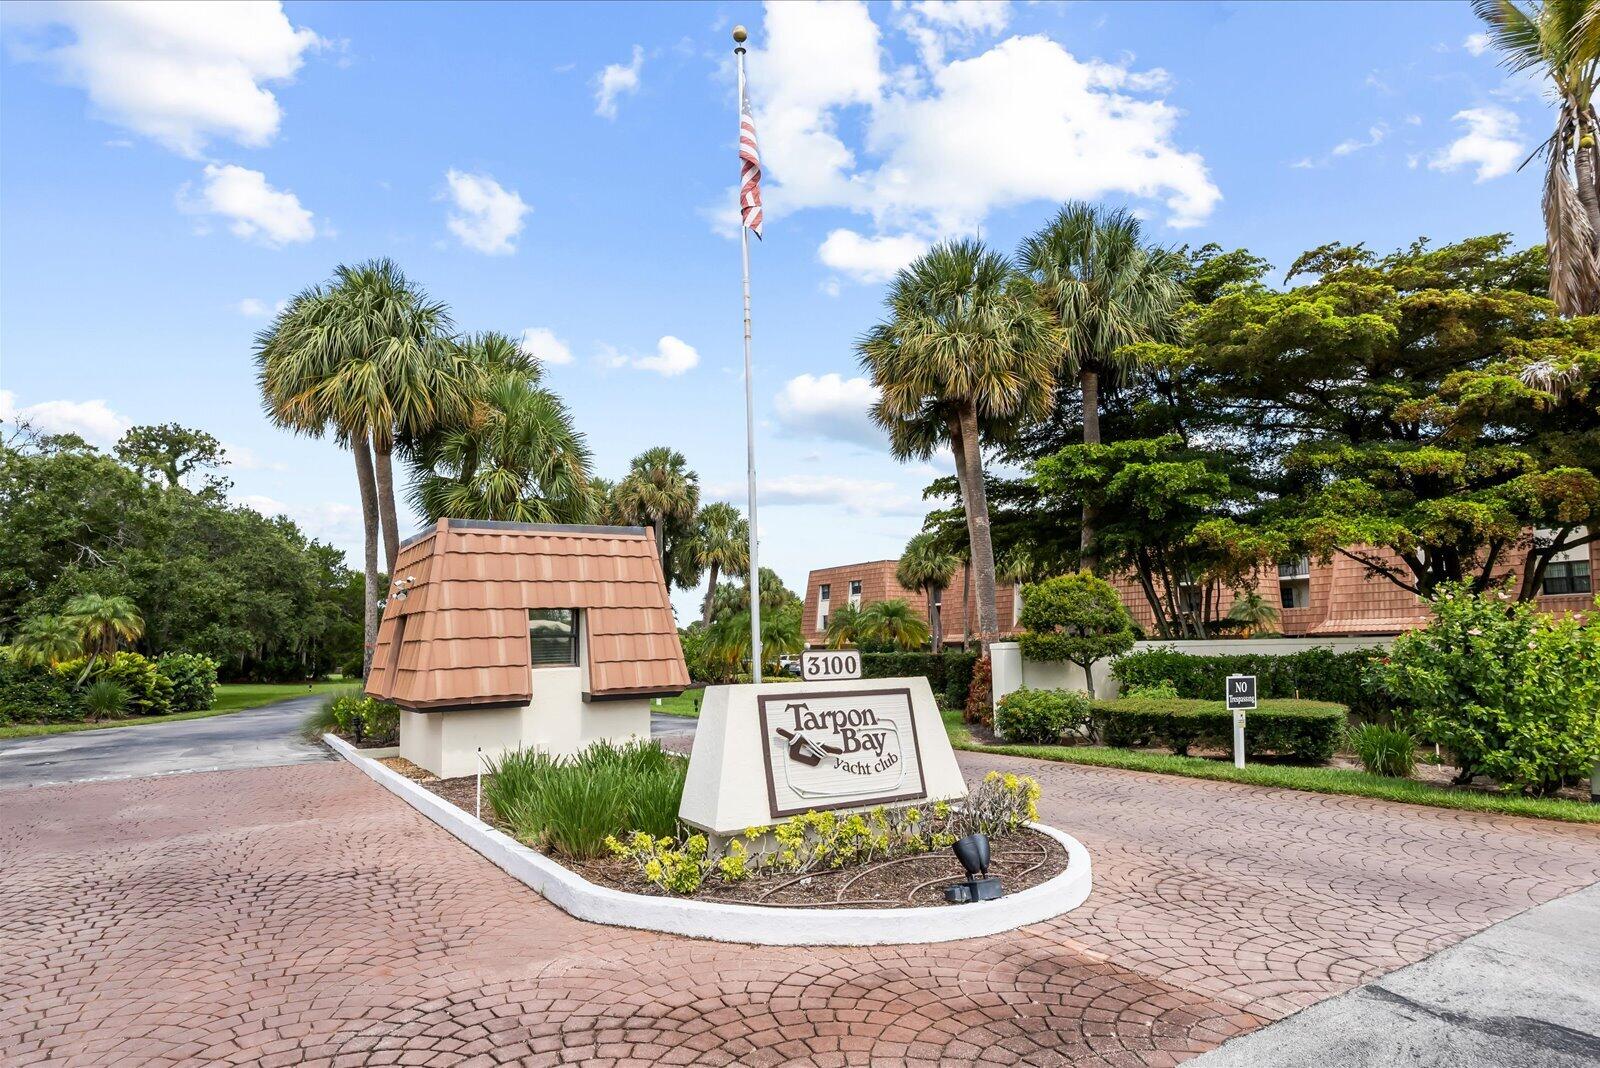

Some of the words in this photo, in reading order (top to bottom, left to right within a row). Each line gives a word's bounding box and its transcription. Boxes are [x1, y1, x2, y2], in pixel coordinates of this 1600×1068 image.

[808, 655, 857, 675] 3100
[1235, 681, 1248, 693] NO
[784, 702, 878, 734] Tarpon
[840, 728, 886, 756] Bay
[833, 757, 872, 775] yacht
[874, 752, 898, 773] club
